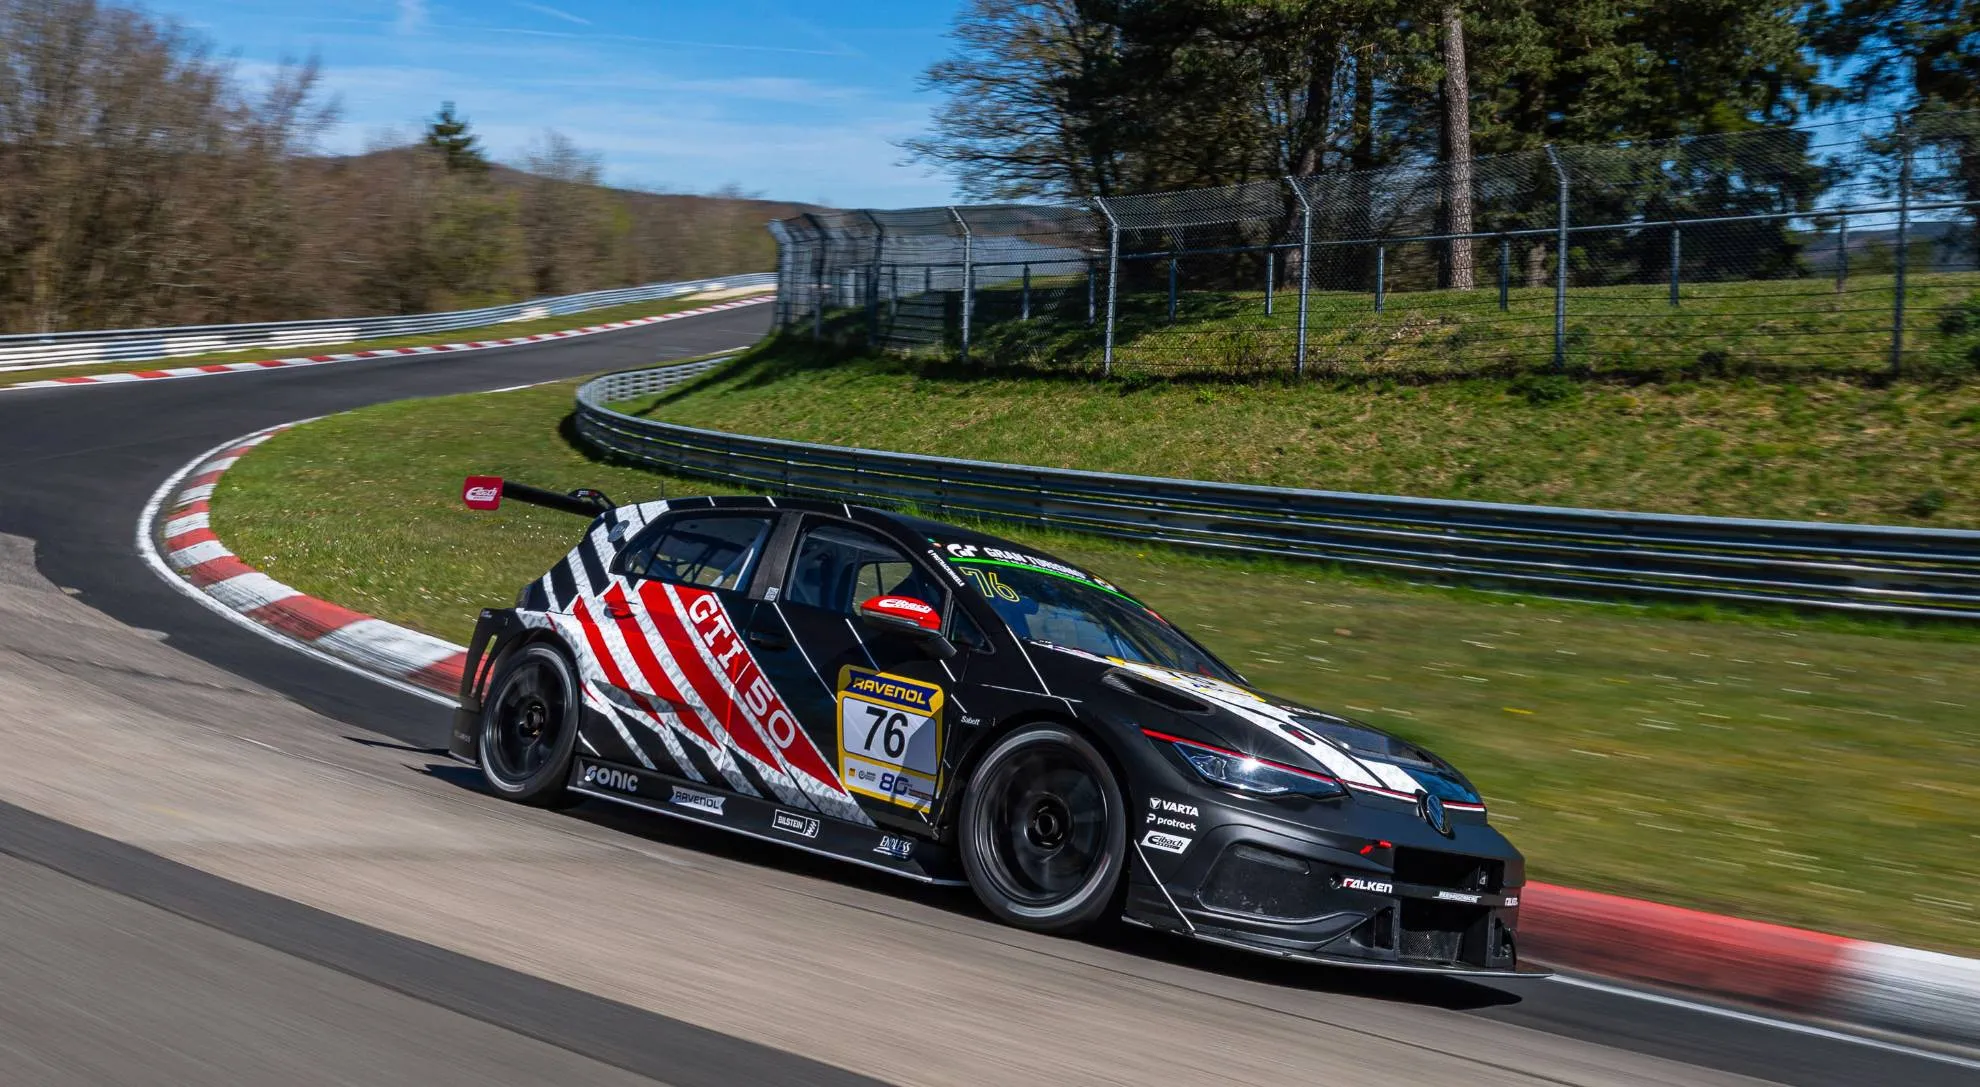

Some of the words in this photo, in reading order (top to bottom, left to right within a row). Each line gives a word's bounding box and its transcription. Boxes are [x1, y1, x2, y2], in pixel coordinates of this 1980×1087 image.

[983, 547, 1028, 563] GRAN
[959, 566, 1020, 602] 76
[689, 594, 744, 670] GTI
[745, 676, 796, 749] 50
[853, 677, 926, 705] RAVENOL
[864, 706, 908, 758] 76
[585, 765, 639, 792] SONIC
[675, 792, 720, 809] RAVENOL
[1162, 800, 1199, 817] VARTA
[777, 815, 804, 830] BILSTEIN
[879, 835, 912, 853] ENDLESS
[1343, 878, 1393, 893] FALKEN
